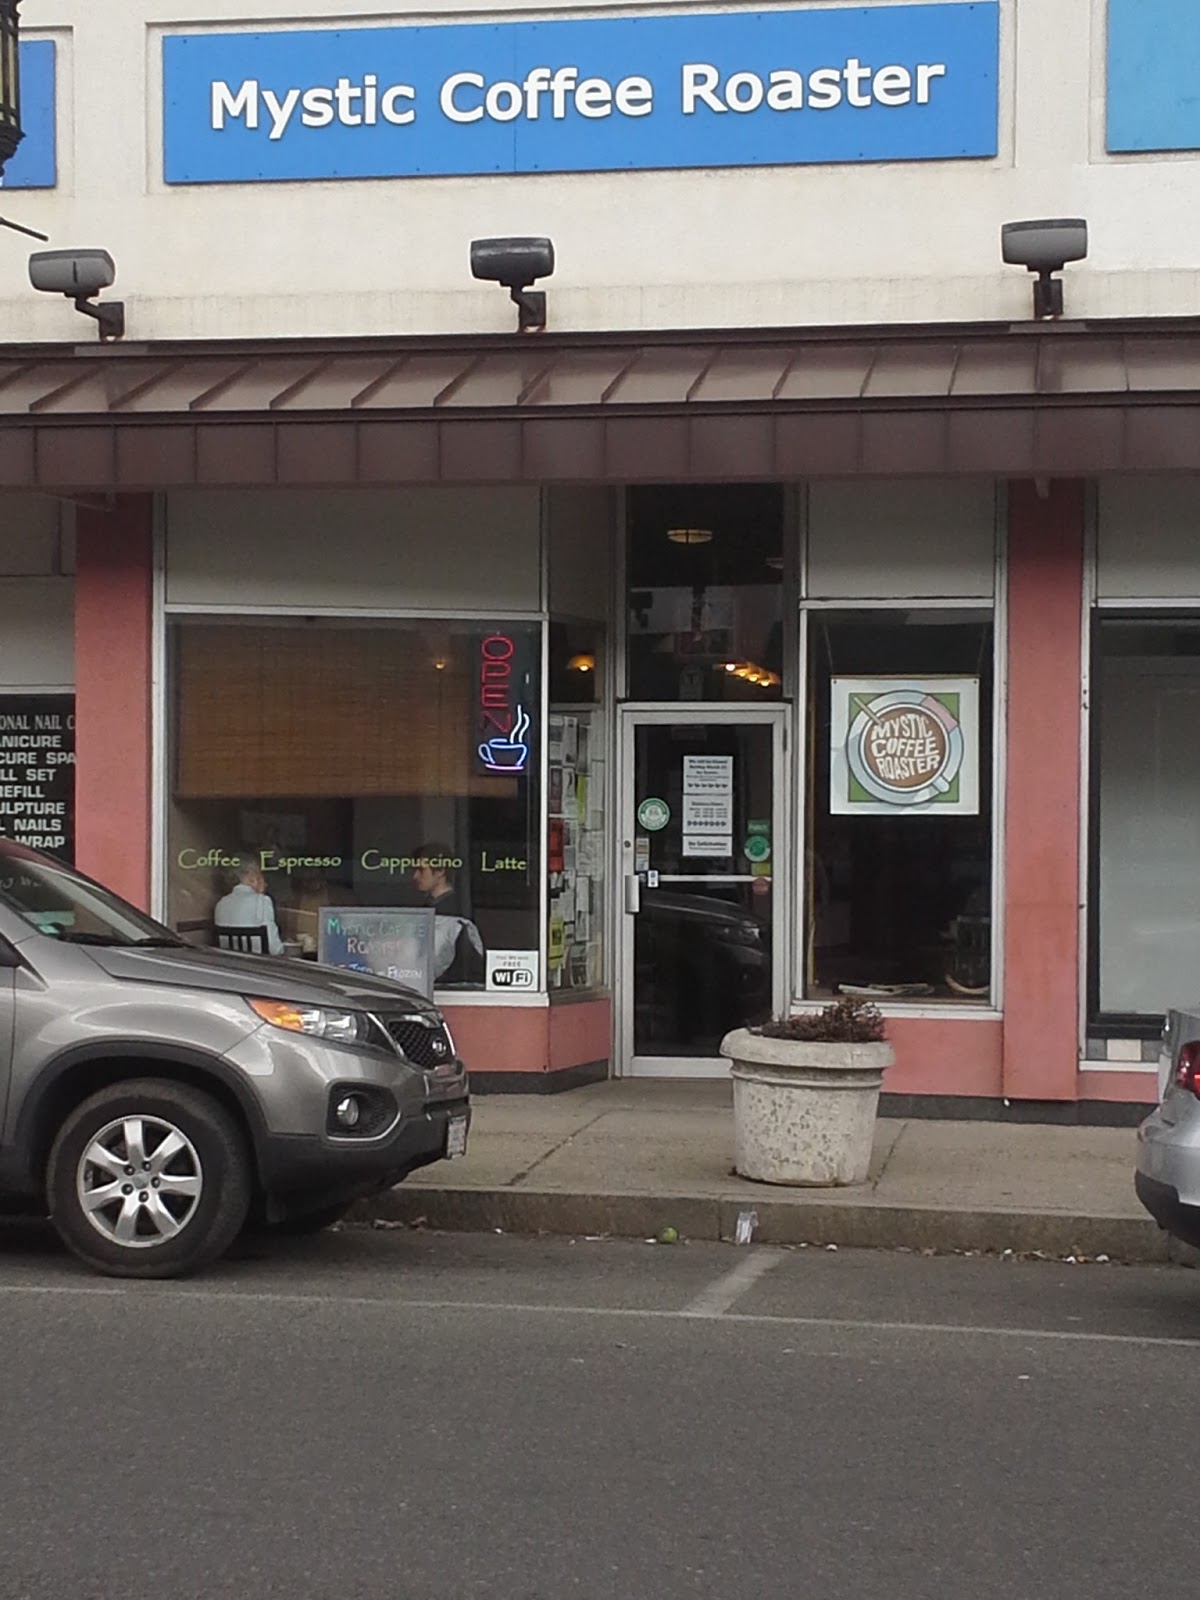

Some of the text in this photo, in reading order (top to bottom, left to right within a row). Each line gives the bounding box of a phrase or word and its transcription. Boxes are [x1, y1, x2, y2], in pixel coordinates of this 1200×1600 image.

[211, 58, 945, 140] Mystic Coffee Roaster
[481, 636, 514, 735] OPEN
[34, 714, 62, 730] NAIL
[871, 713, 933, 740] MYSTIC
[0, 735, 61, 748] NICURE
[871, 737, 940, 757] COFFEE
[46, 751, 76, 765] SPA
[875, 754, 941, 780] ROASTER
[26, 768, 56, 781] SET
[14, 818, 62, 831] NAILS
[15, 835, 65, 848] WRAP
[177, 848, 528, 875] Coffee Espresso Cappuccino Latte
